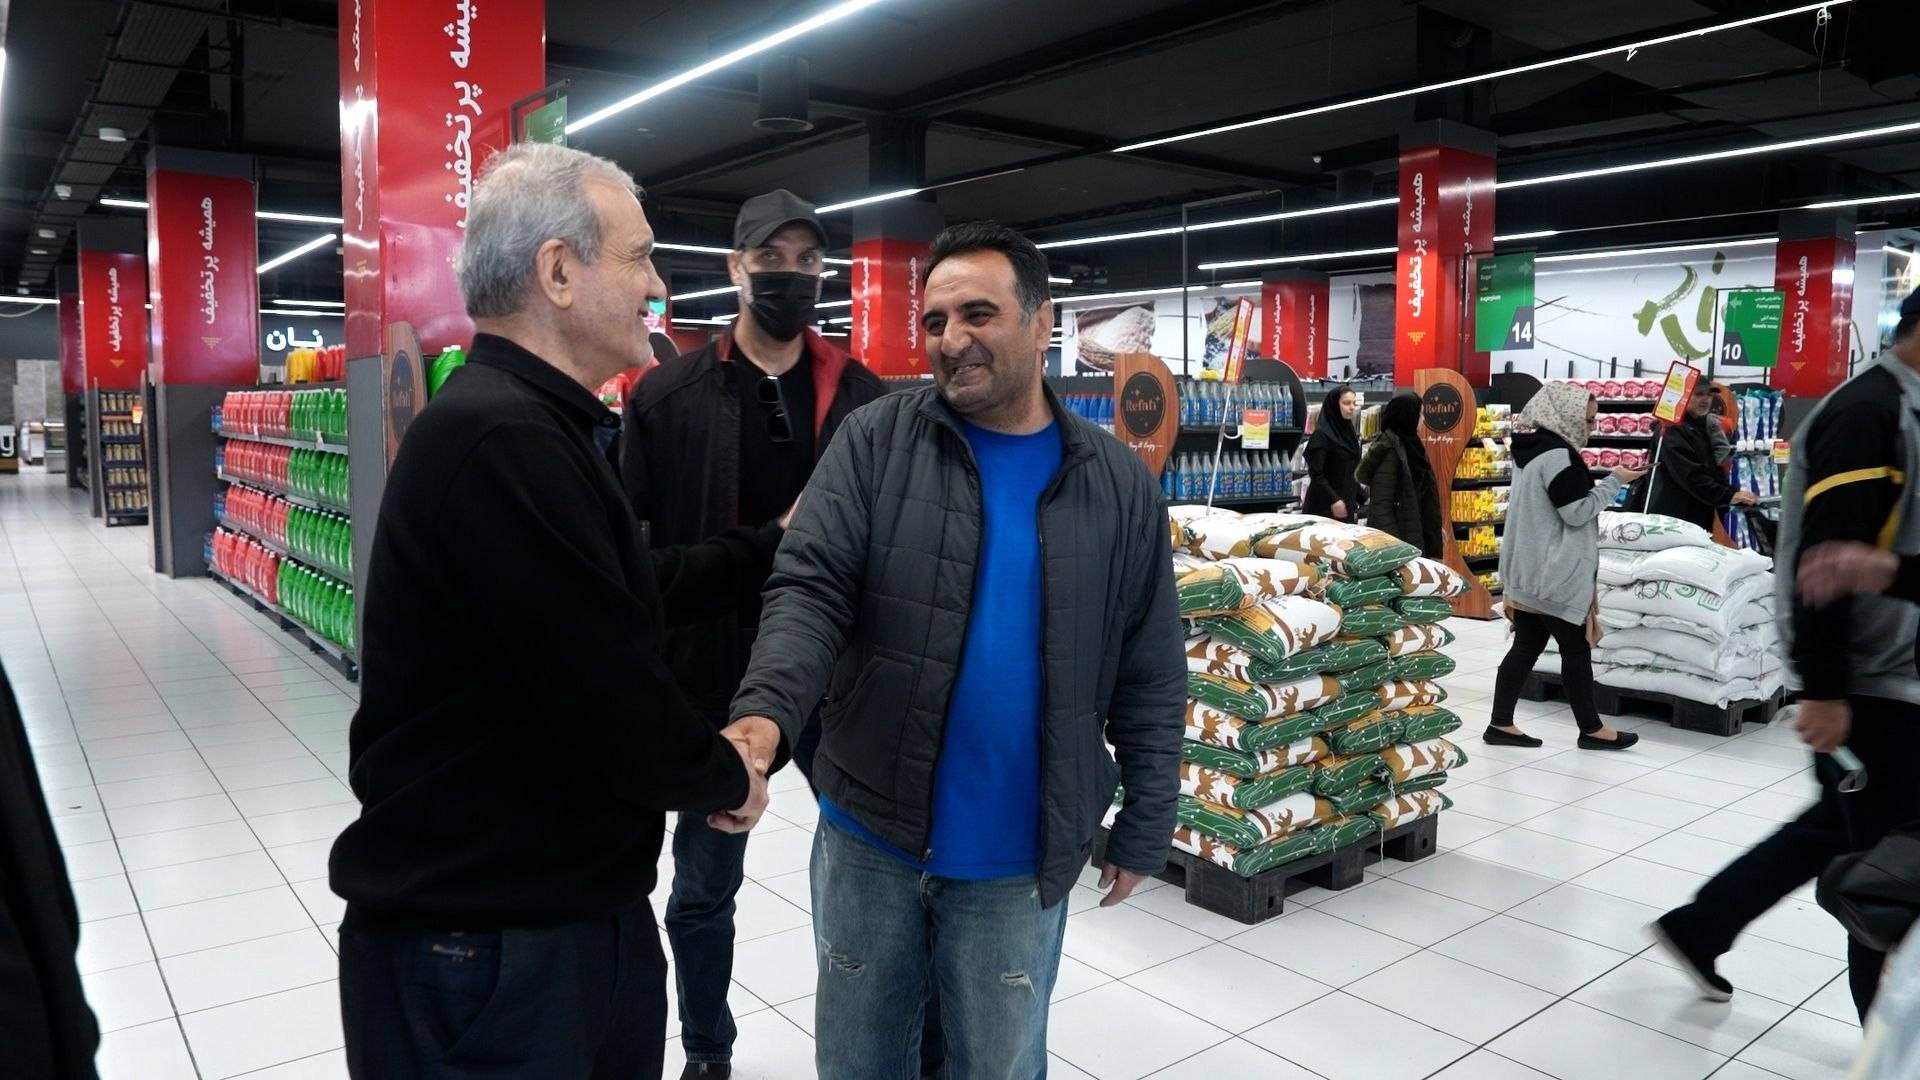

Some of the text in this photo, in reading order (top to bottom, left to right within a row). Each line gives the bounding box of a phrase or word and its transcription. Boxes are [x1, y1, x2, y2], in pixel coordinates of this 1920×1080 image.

[1410, 173, 1425, 233] همیشه
[199, 197, 216, 250] همیشه
[908, 257, 918, 296] همیشه
[1796, 256, 1809, 296] همیشه
[266, 326, 324, 351] نان
[1512, 321, 1532, 343] 14
[1723, 343, 1741, 360] 10
